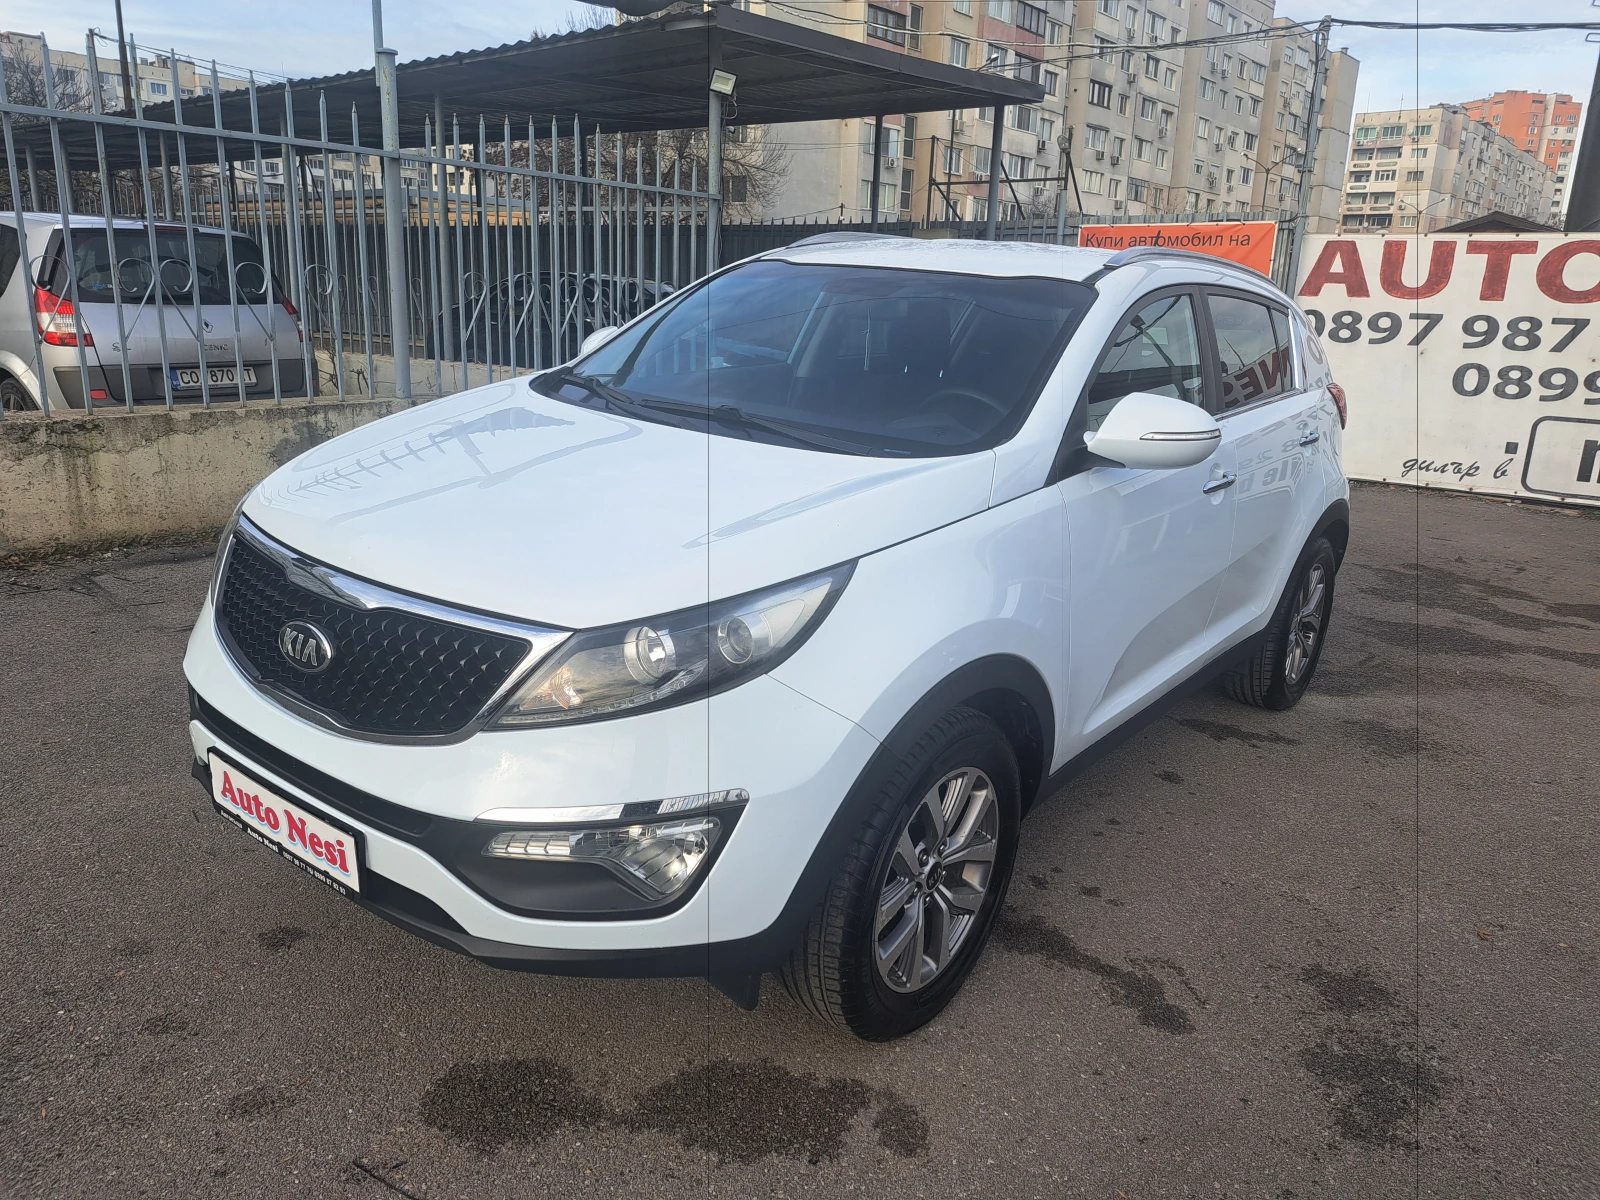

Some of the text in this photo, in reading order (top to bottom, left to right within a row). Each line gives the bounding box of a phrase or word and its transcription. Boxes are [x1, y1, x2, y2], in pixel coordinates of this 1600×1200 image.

[1085, 231, 1251, 247] Купи автомобил на
[1461, 314, 1591, 353] 987
[283, 627, 317, 666] KIA
[221, 771, 350, 873] Auto Nesi
